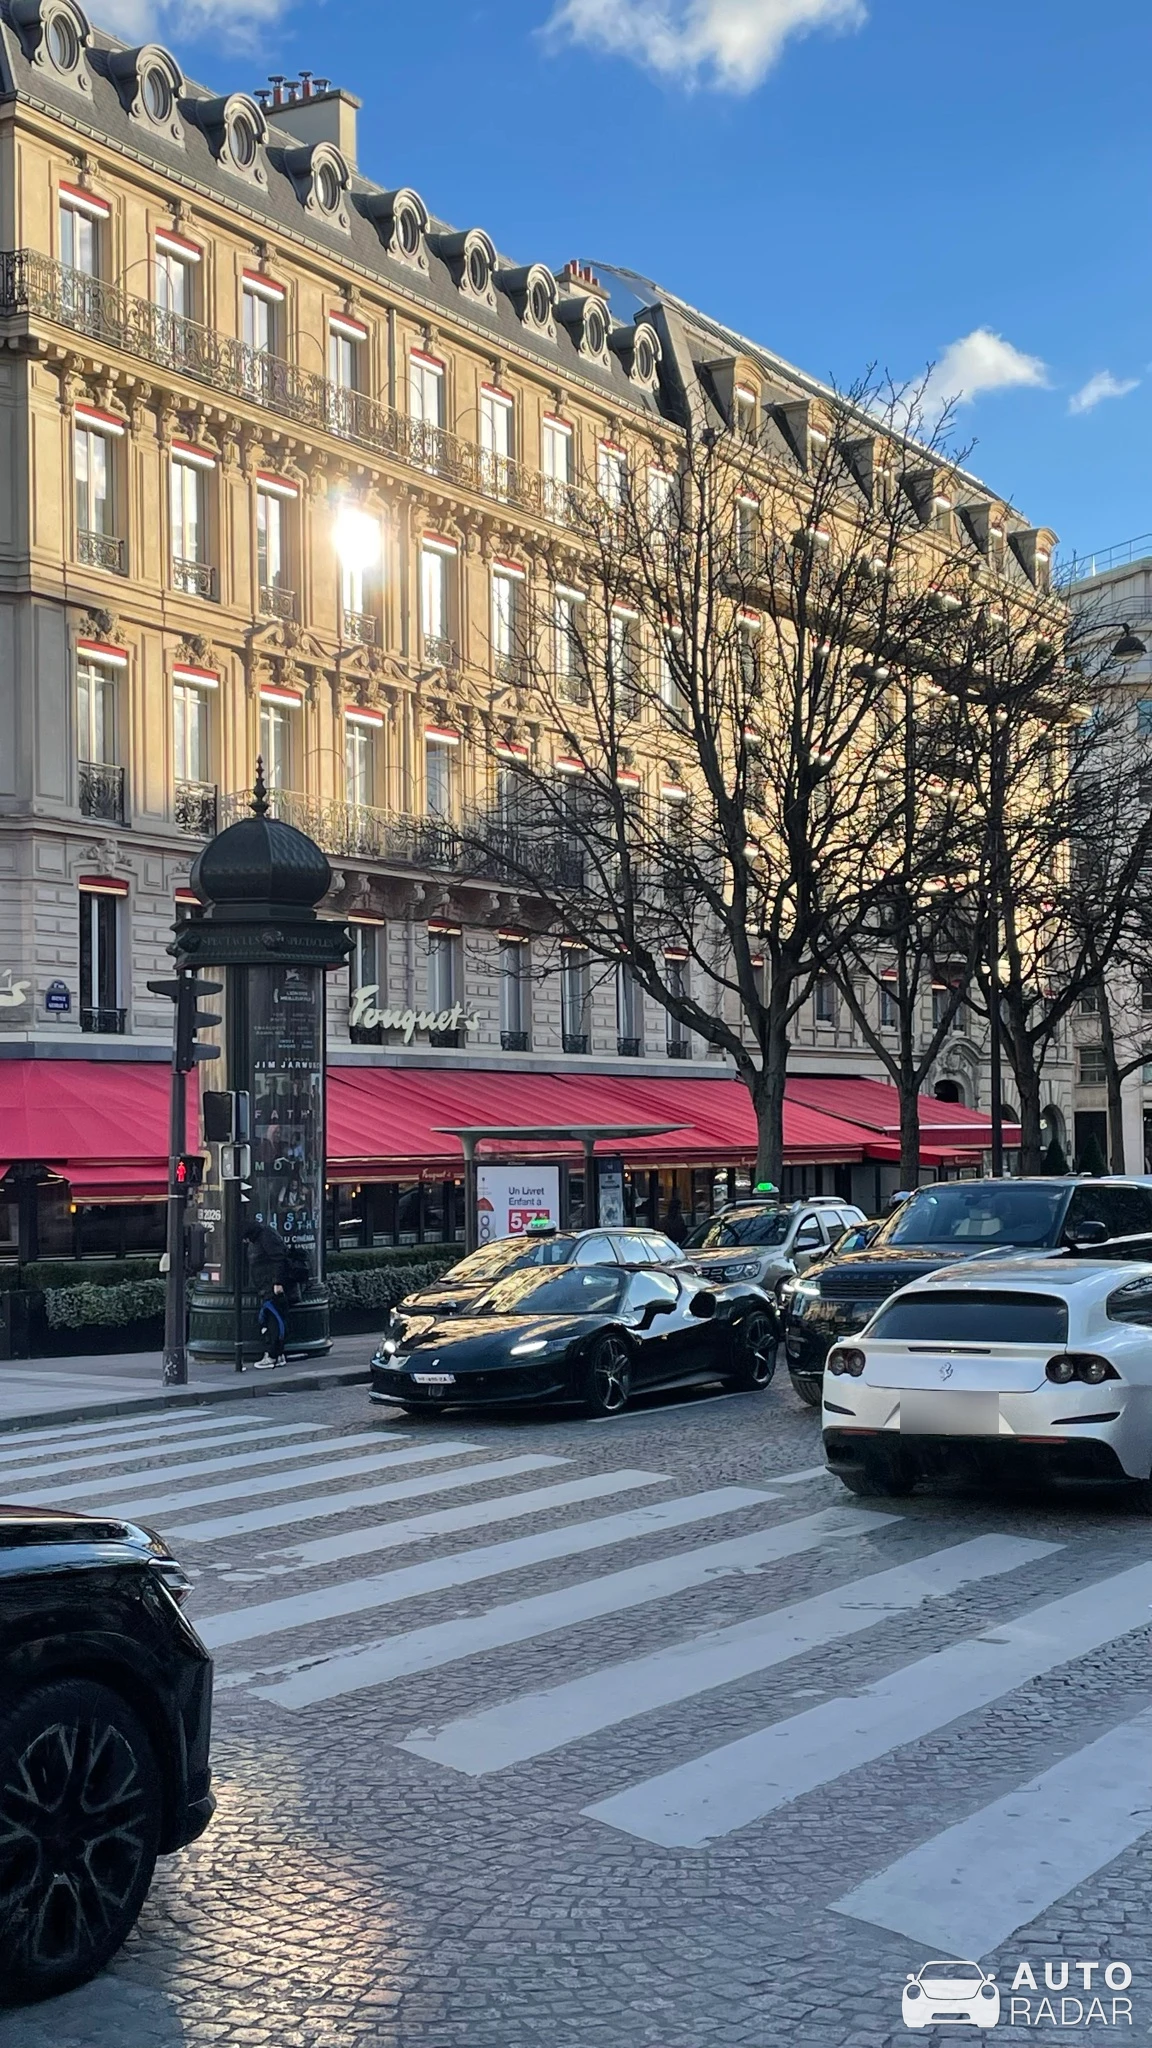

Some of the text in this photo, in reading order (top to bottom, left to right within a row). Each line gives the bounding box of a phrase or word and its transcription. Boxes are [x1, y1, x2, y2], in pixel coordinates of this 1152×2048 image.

[201, 935, 260, 946] SPECTACLES
[350, 984, 481, 1044] Fouquet's
[254, 1061, 276, 1069] JIM
[508, 1187, 545, 1196] Un Livret
[508, 1198, 535, 1206] Enfant
[203, 1209, 222, 1221] 2026
